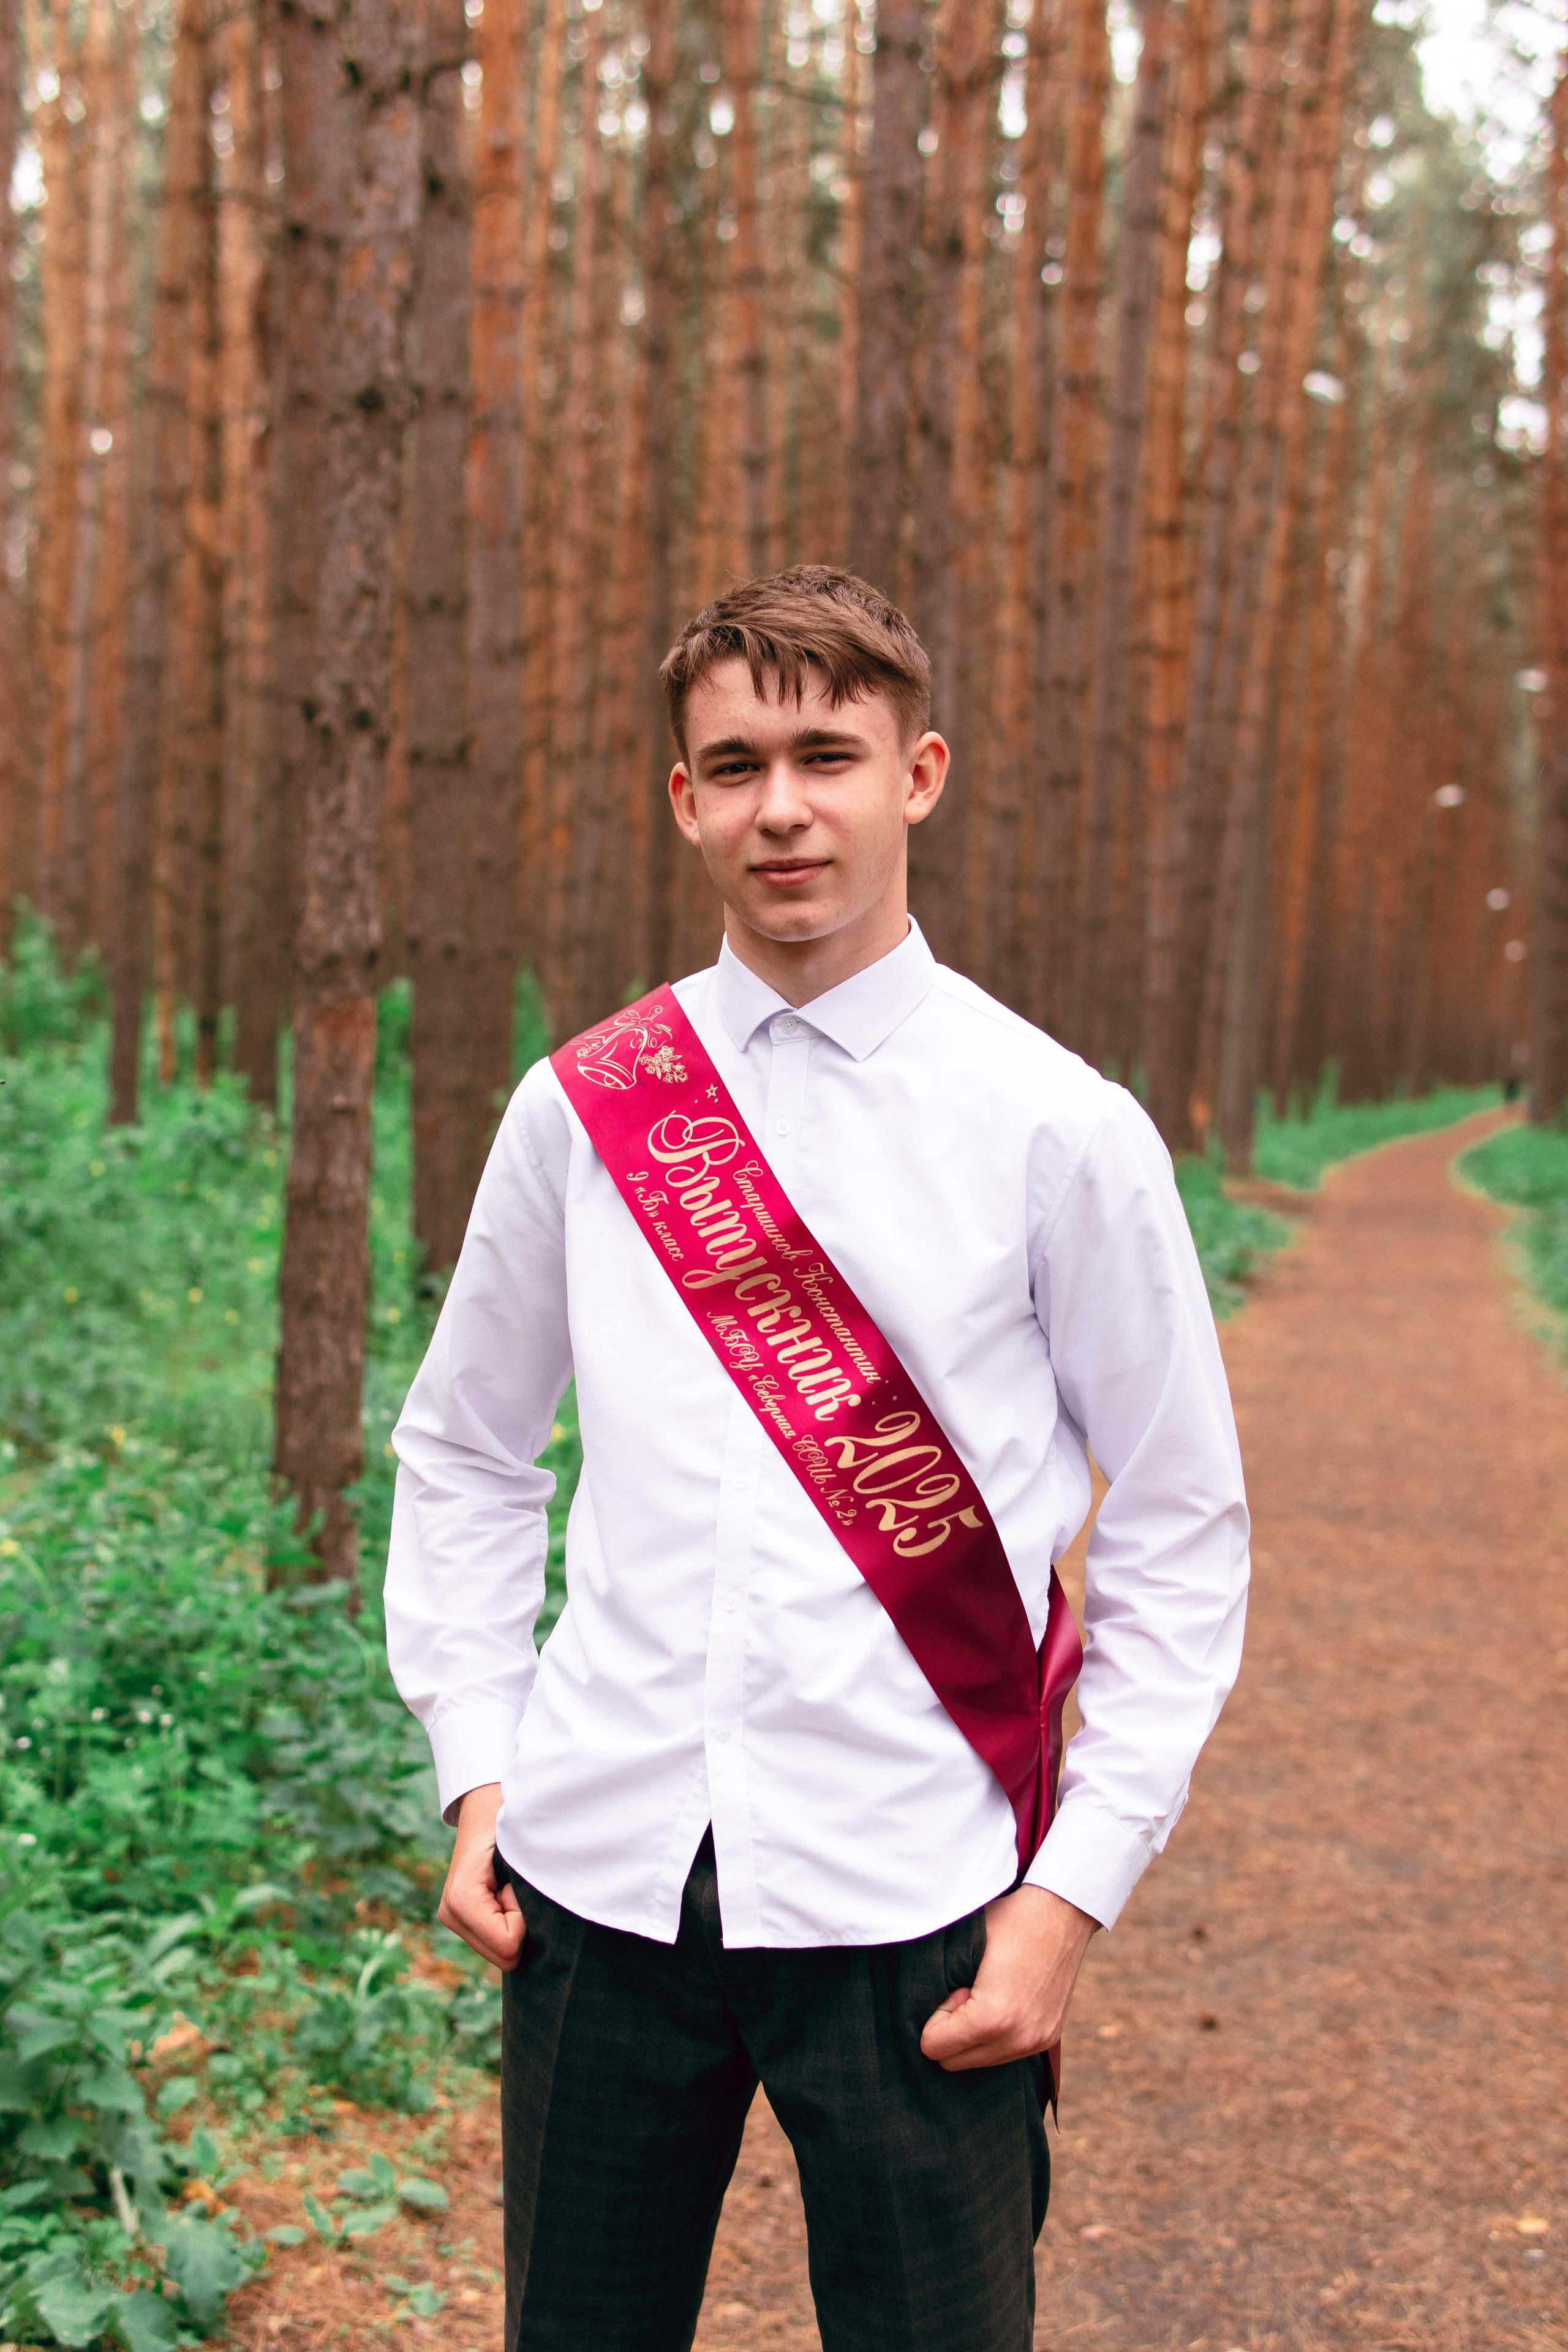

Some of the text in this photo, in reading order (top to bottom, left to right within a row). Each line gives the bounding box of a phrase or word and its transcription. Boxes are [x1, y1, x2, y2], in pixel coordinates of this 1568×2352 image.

[627, 1171, 649, 1181] 9
[652, 1221, 684, 1262] класс
[733, 1160, 881, 1384] Старшинов Константин
[647, 1109, 984, 1558] Выпускник 2025
[707, 1311, 764, 1371] МБОУ
